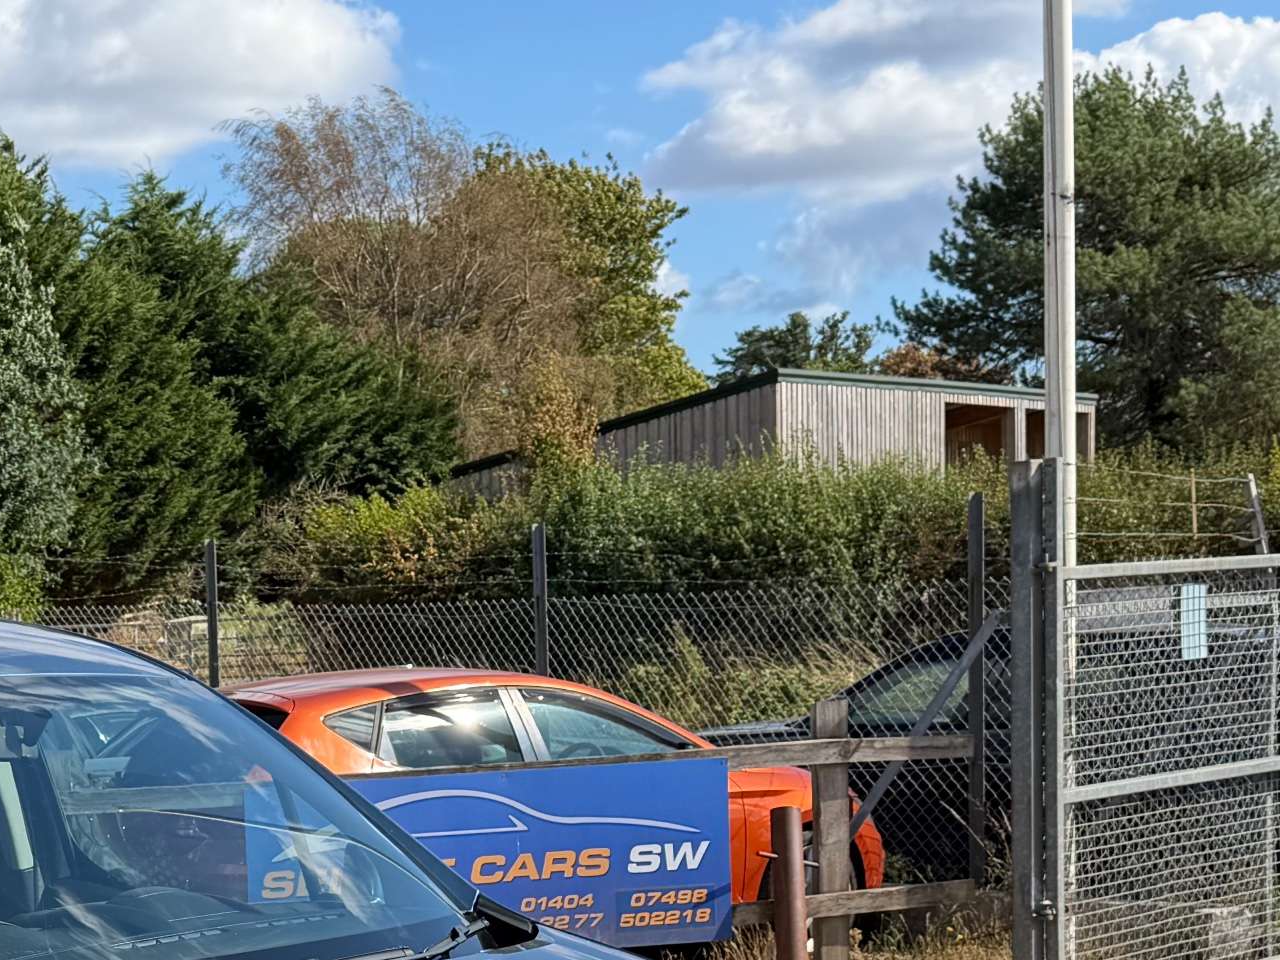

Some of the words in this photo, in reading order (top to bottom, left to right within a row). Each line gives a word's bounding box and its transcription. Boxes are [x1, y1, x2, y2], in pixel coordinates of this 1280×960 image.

[470, 847, 611, 885] CARS
[627, 840, 710, 874] SW
[520, 893, 595, 912] 01404
[574, 912, 604, 929] 77
[619, 908, 711, 928] 502218
